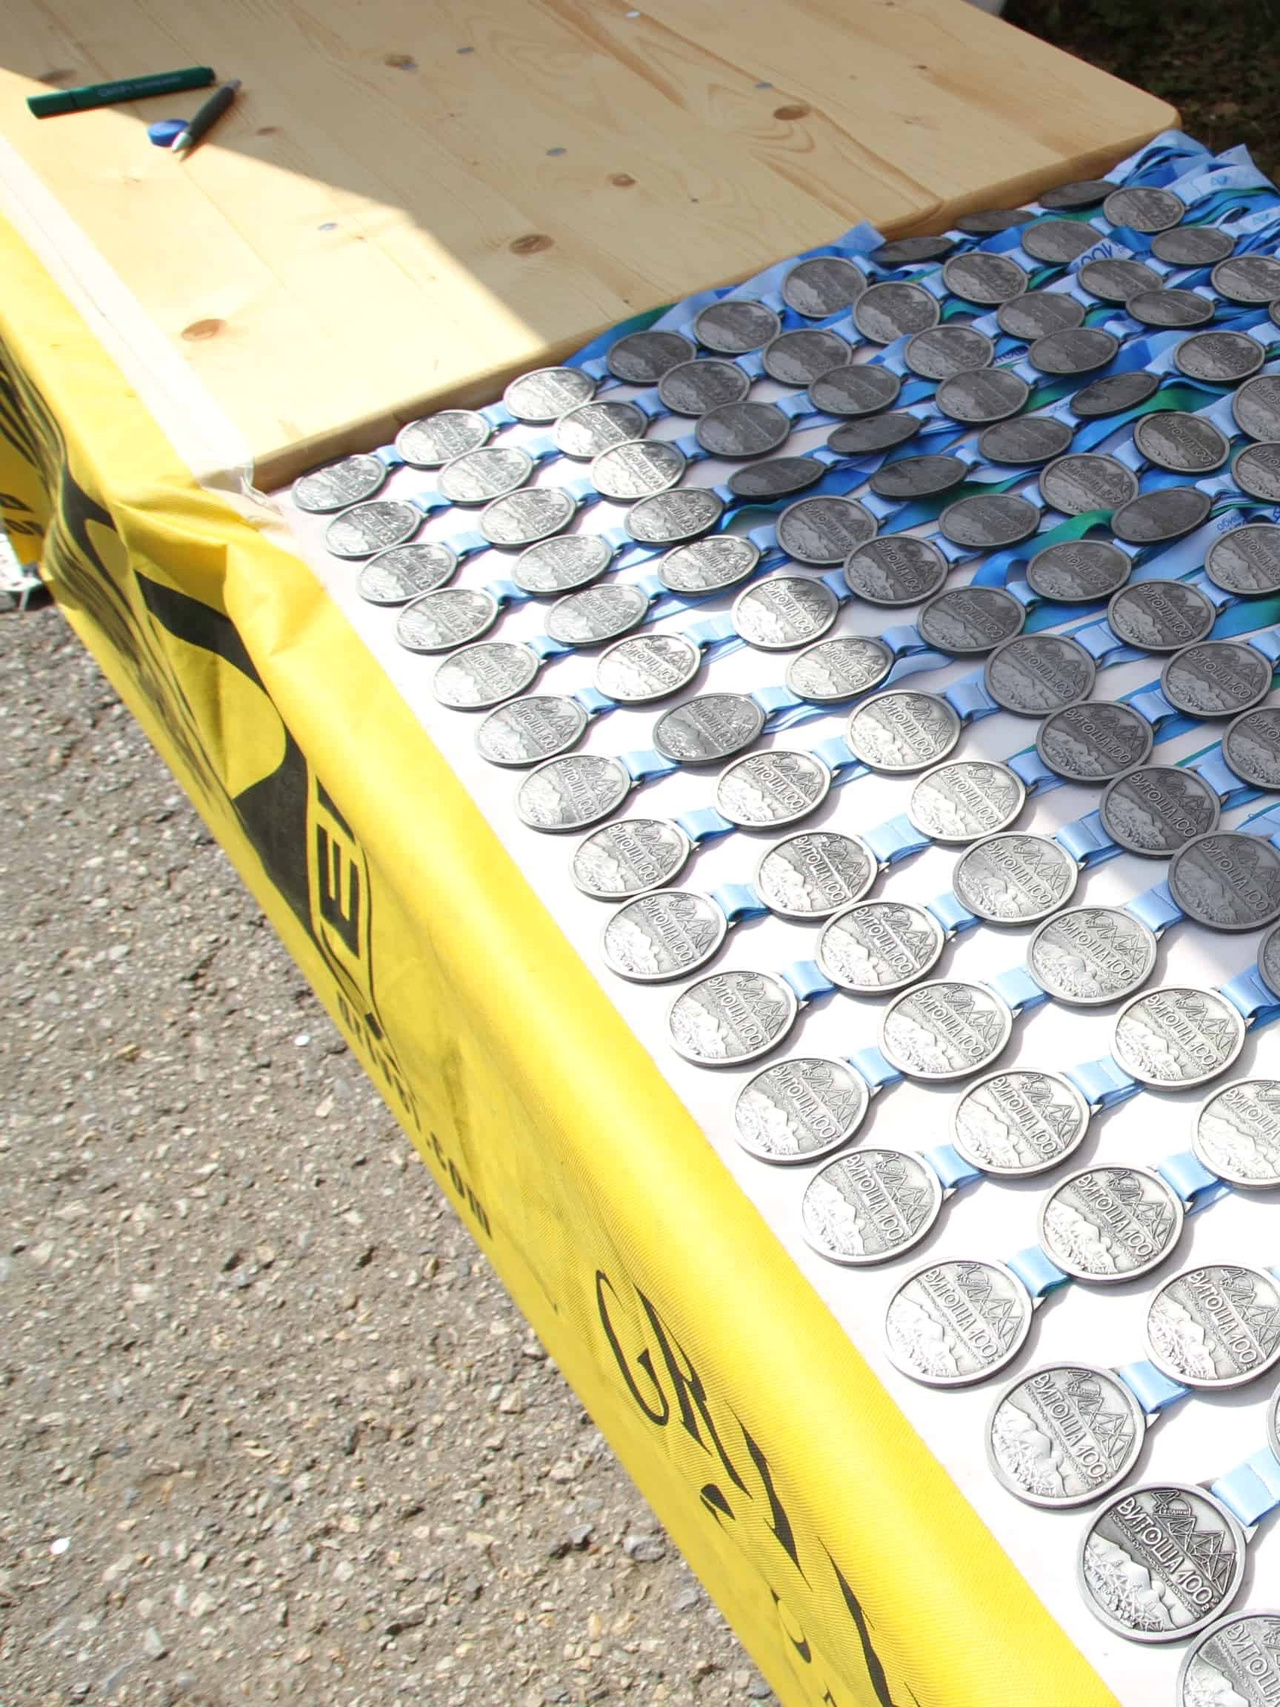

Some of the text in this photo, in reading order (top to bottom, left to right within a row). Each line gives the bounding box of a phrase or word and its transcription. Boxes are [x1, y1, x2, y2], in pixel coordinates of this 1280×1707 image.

[1201, 840, 1245, 888] ВИТОША
[1057, 918, 1111, 966] ВИТОША
[913, 990, 962, 1040] ВИТОША
[1145, 992, 1195, 1046] ВИТОША
[772, 1066, 816, 1120] ВИТОША
[990, 1076, 1037, 1135] ВИТОША
[846, 1154, 889, 1216] ВИТОША
[1077, 1174, 1152, 1256] ВИТОША 100
[924, 1267, 997, 1358] ВИТОША 100
[1188, 1269, 1257, 1364] ВИТОША 100
[1033, 1371, 1106, 1478] ВИТОША 100
[1117, 1497, 1212, 1605] ВИТОША 100
